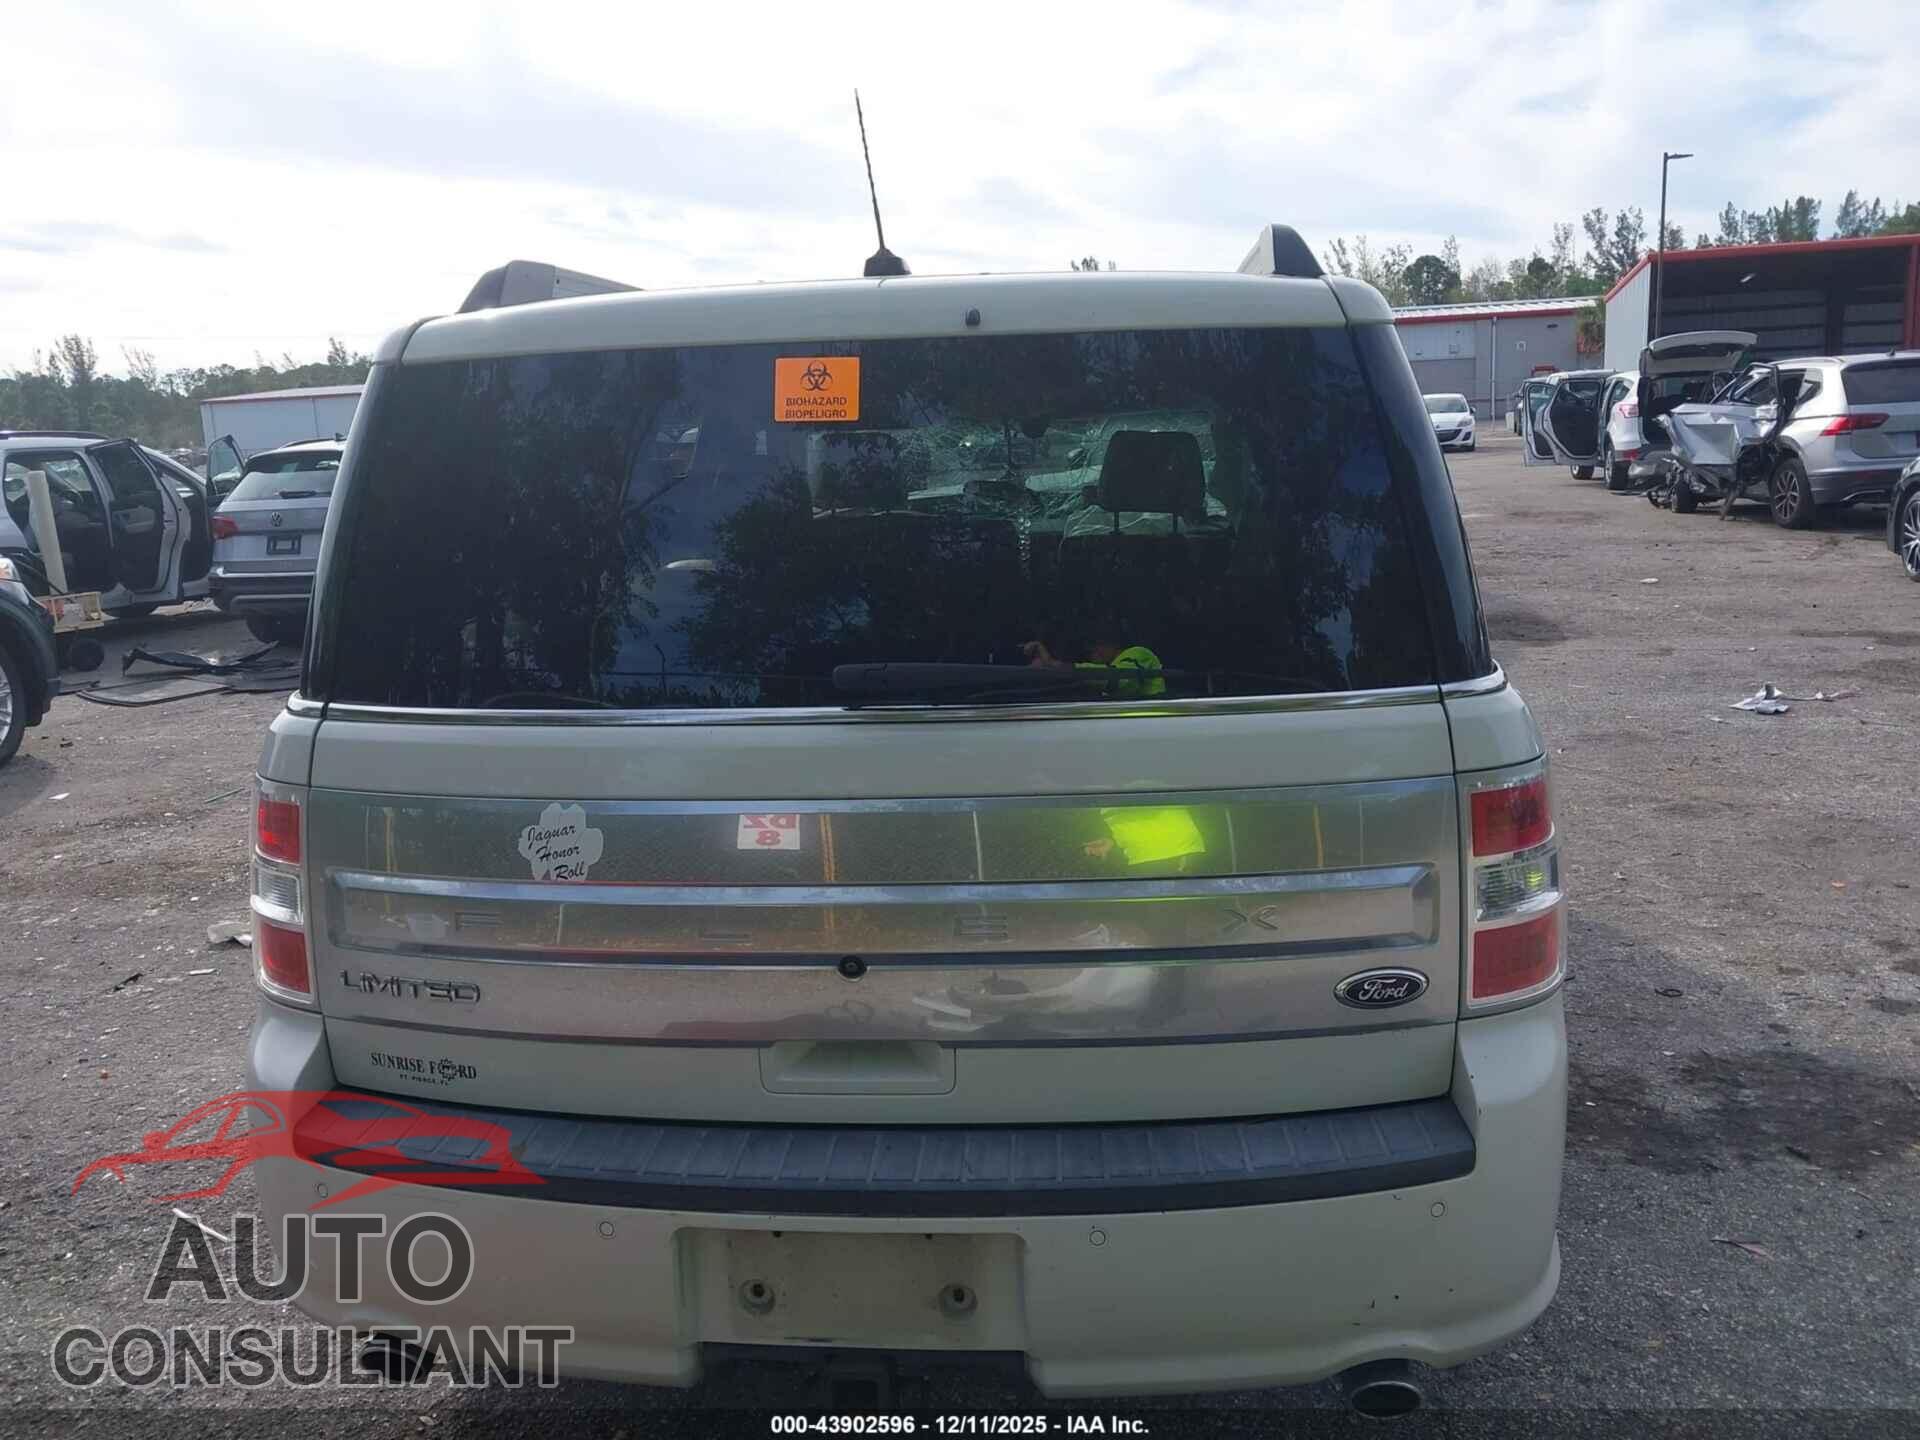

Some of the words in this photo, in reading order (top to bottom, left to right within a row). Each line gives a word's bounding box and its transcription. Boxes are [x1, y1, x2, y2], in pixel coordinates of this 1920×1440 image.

[785, 396, 848, 407] BIOHAZARD
[784, 409, 848, 420] BIOPELIGRO
[527, 825, 576, 850] Jaguar
[535, 845, 580, 862] Honor
[553, 861, 585, 880] Roll
[339, 969, 481, 1004] LIMITED
[1358, 978, 1409, 1001] Ford
[369, 1051, 425, 1074] SUNRISE
